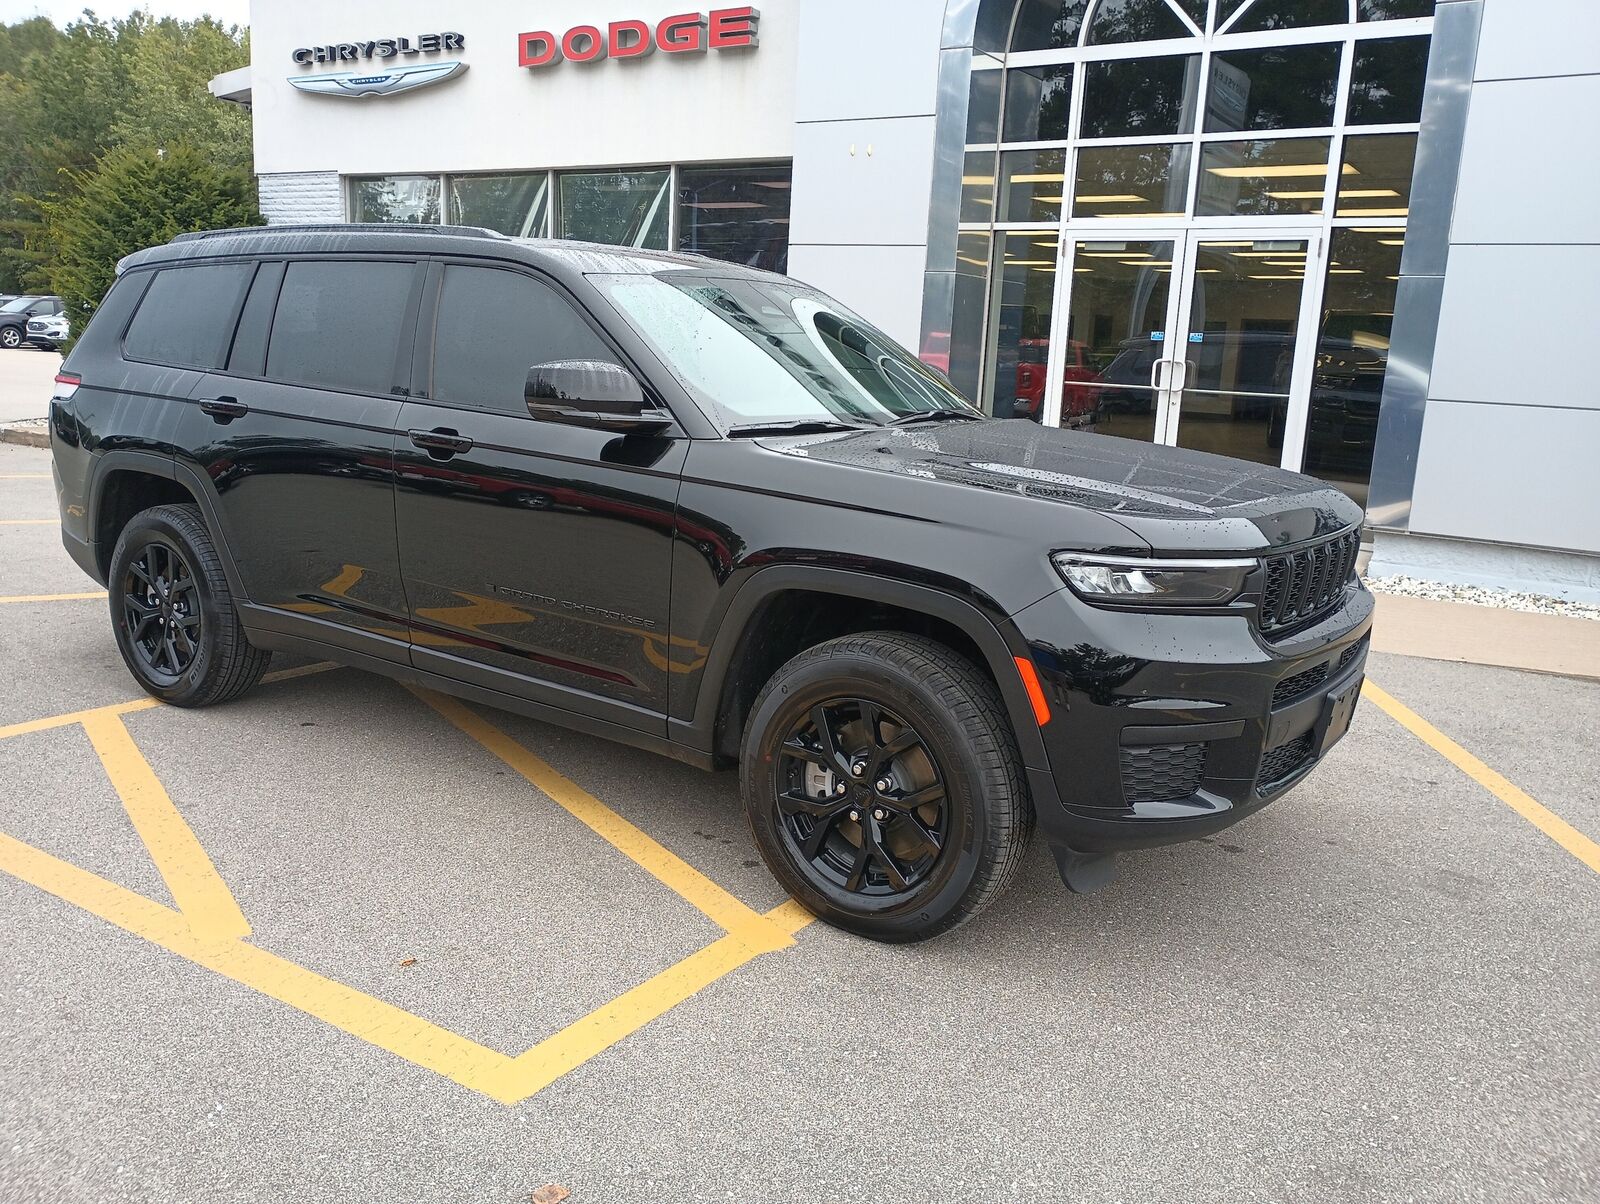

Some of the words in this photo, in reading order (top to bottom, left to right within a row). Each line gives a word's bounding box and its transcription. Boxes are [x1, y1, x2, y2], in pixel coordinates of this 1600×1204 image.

[292, 31, 464, 65] CHRYSLER
[518, 6, 758, 67] DODGE
[561, 600, 656, 629] CHEROKEE
